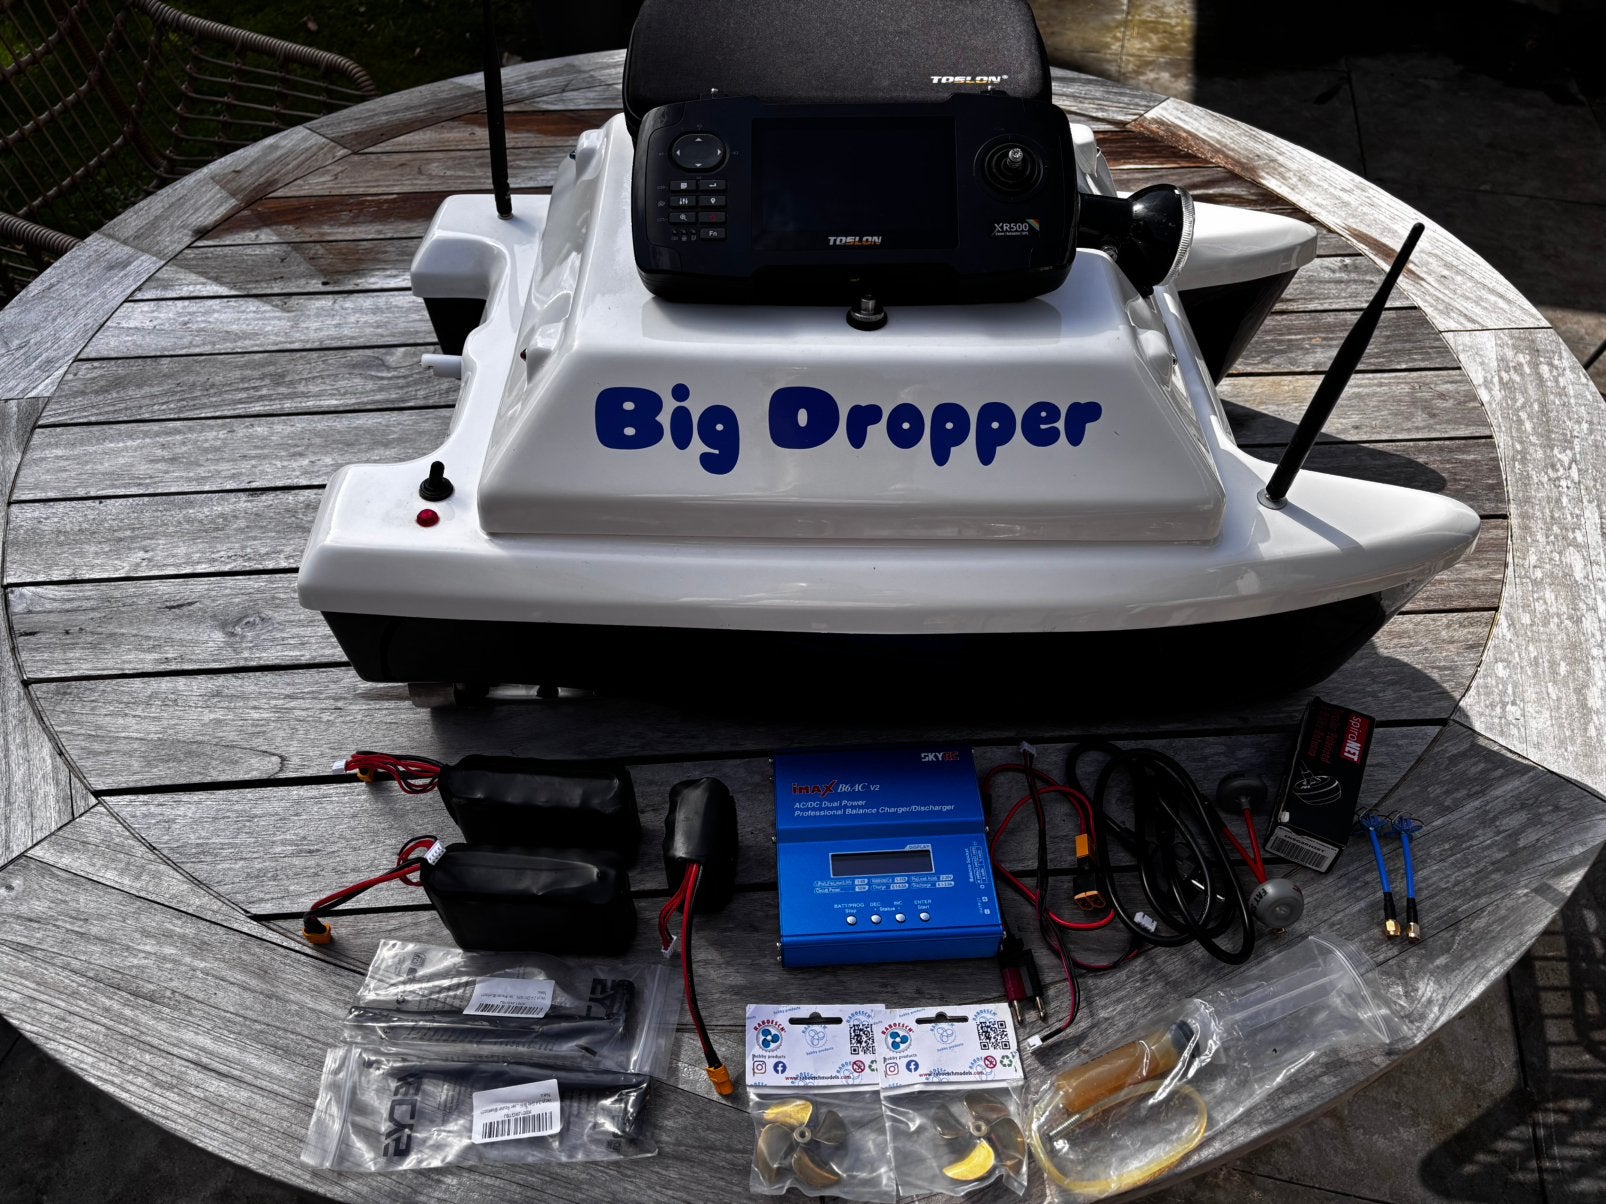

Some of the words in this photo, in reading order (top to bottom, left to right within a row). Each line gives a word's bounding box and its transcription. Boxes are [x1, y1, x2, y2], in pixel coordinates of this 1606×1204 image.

[993, 222, 1029, 232] XR500
[595, 383, 740, 475] Big
[768, 386, 1102, 466] Dropper
[794, 801, 820, 809] AC/DC
[795, 808, 844, 817] Professional
[846, 807, 877, 815] Balance
[879, 804, 955, 813] Charger/Discharger
[753, 1019, 786, 1032] RABOESCH
[881, 1022, 914, 1035] RABOESCH
